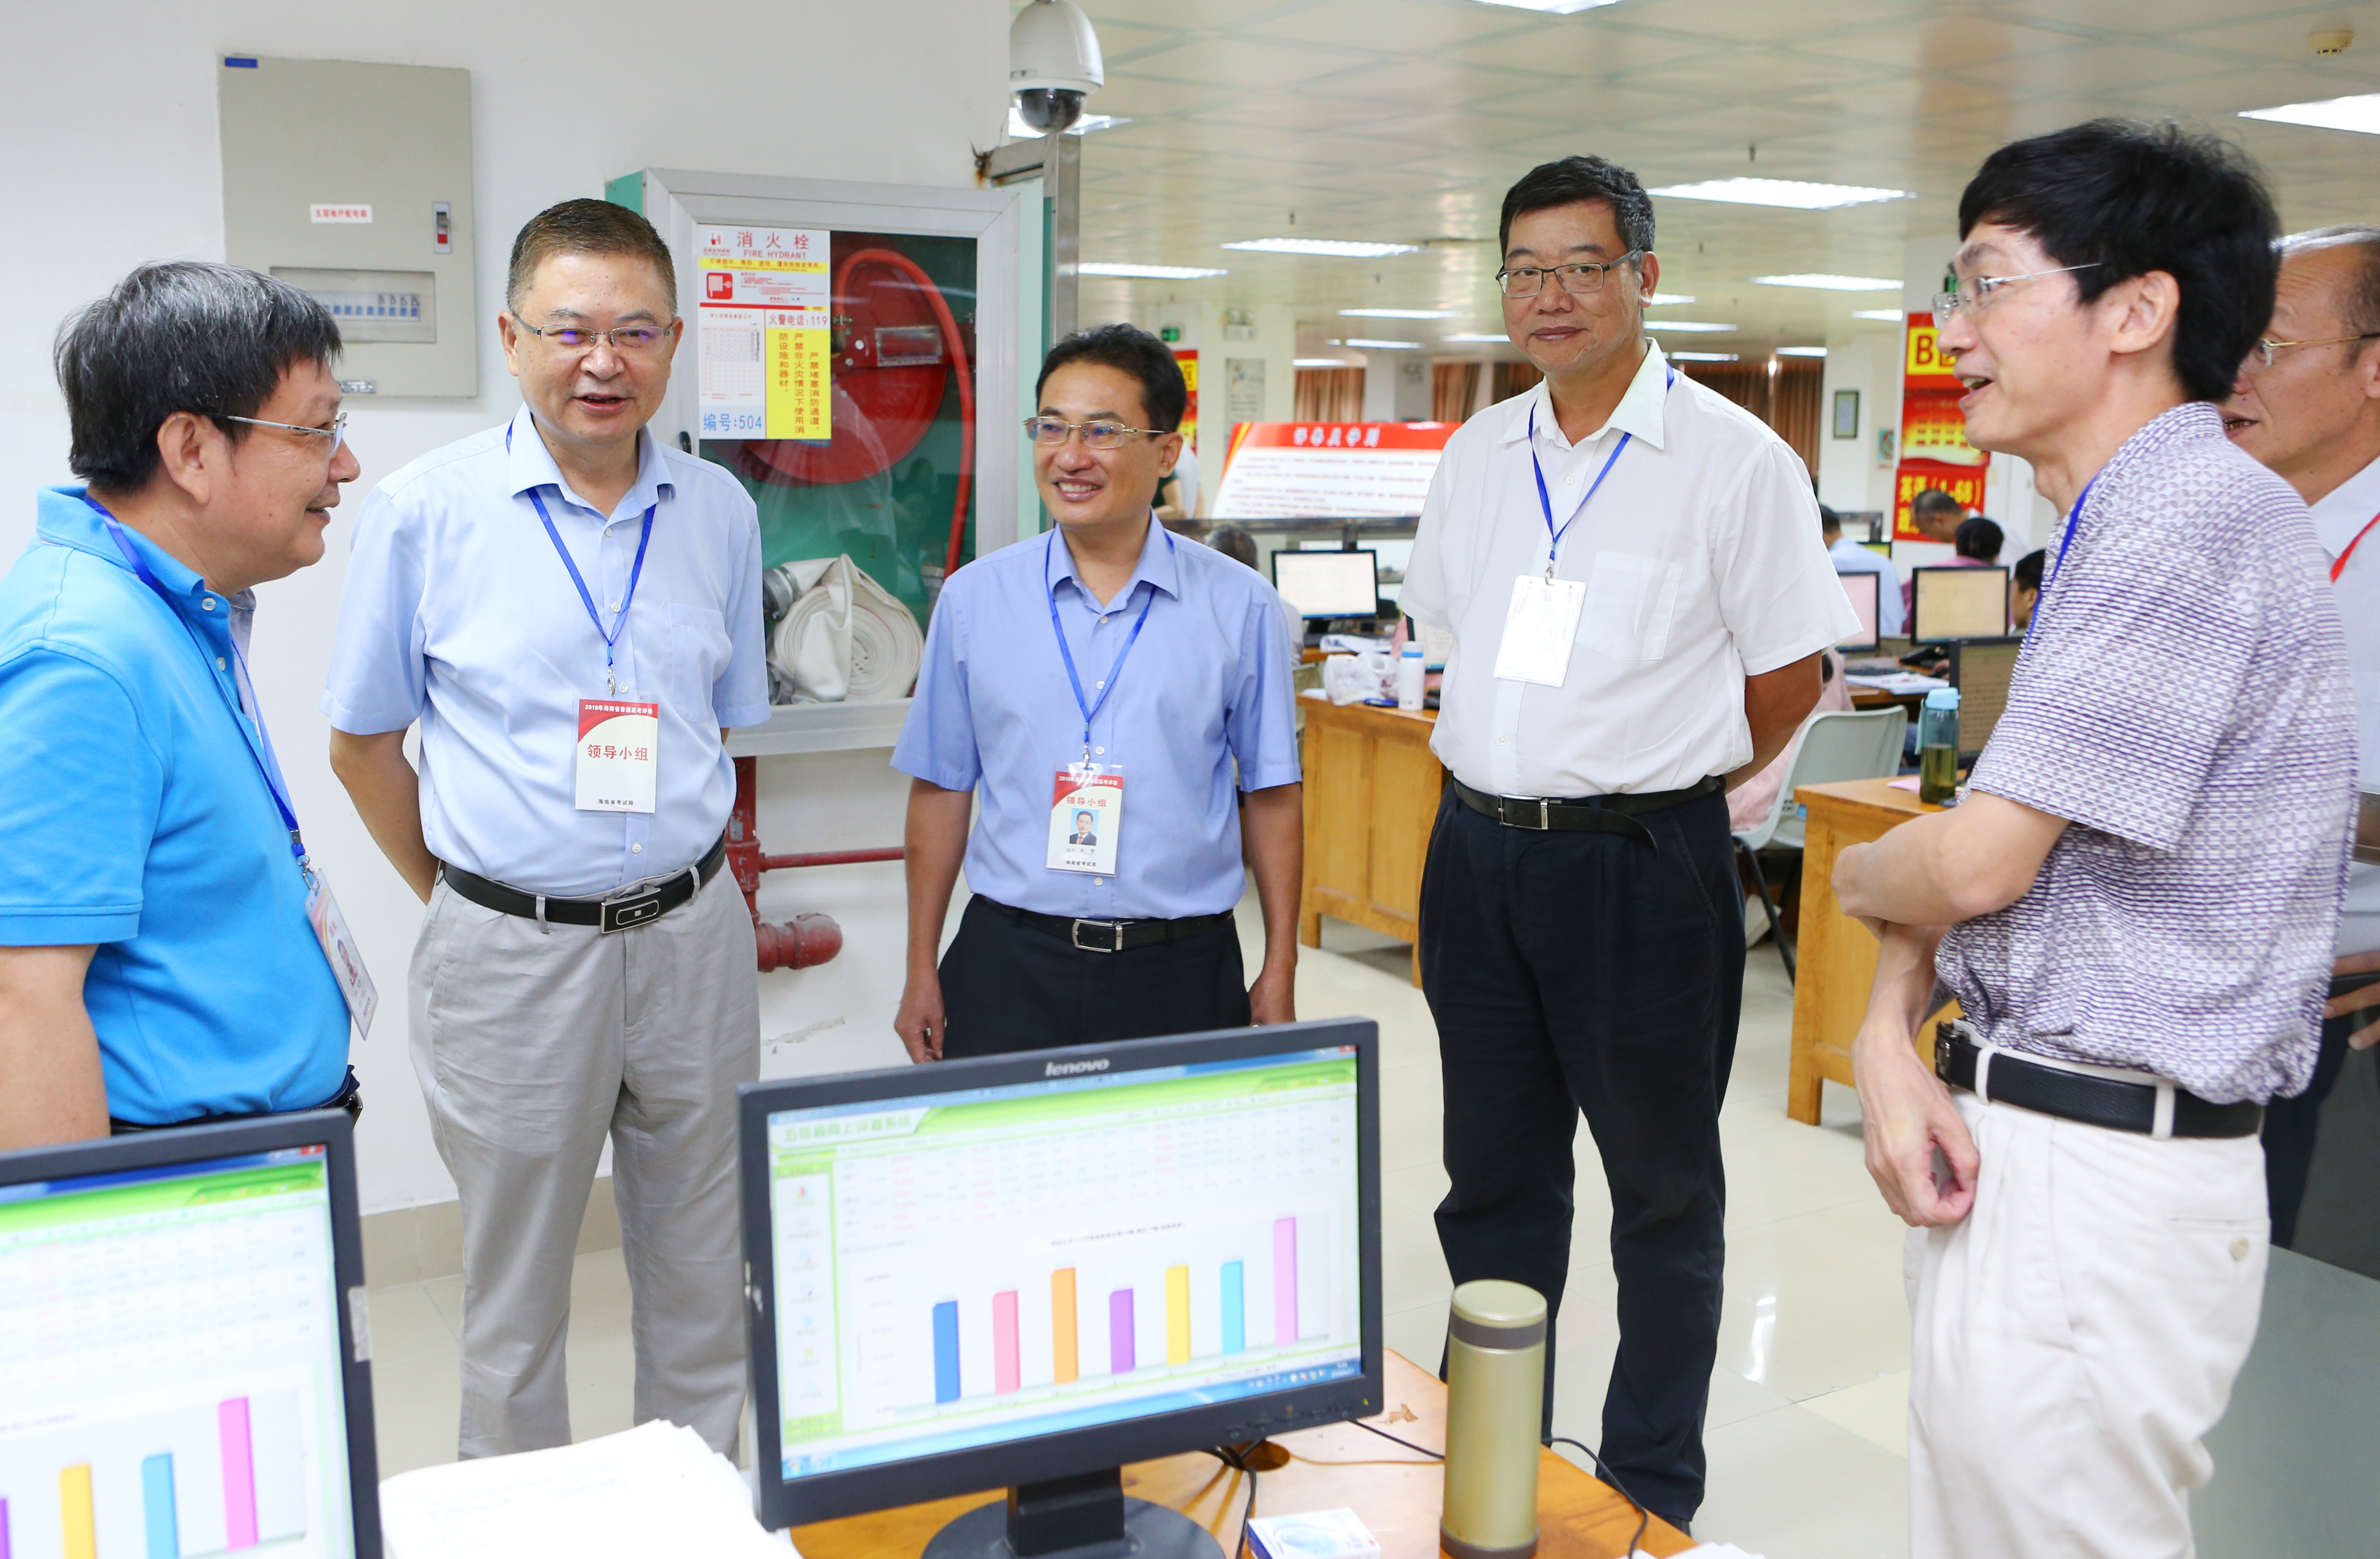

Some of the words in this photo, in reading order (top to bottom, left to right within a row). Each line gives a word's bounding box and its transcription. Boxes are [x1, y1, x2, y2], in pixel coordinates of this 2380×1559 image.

[737, 231, 809, 249] 消火栓
[585, 704, 653, 715] 2018年海南省普通高考评卷
[587, 744, 648, 761] 领导小组
[1066, 796, 1107, 807] 领导小组
[1045, 1058, 1110, 1077] lenovo
